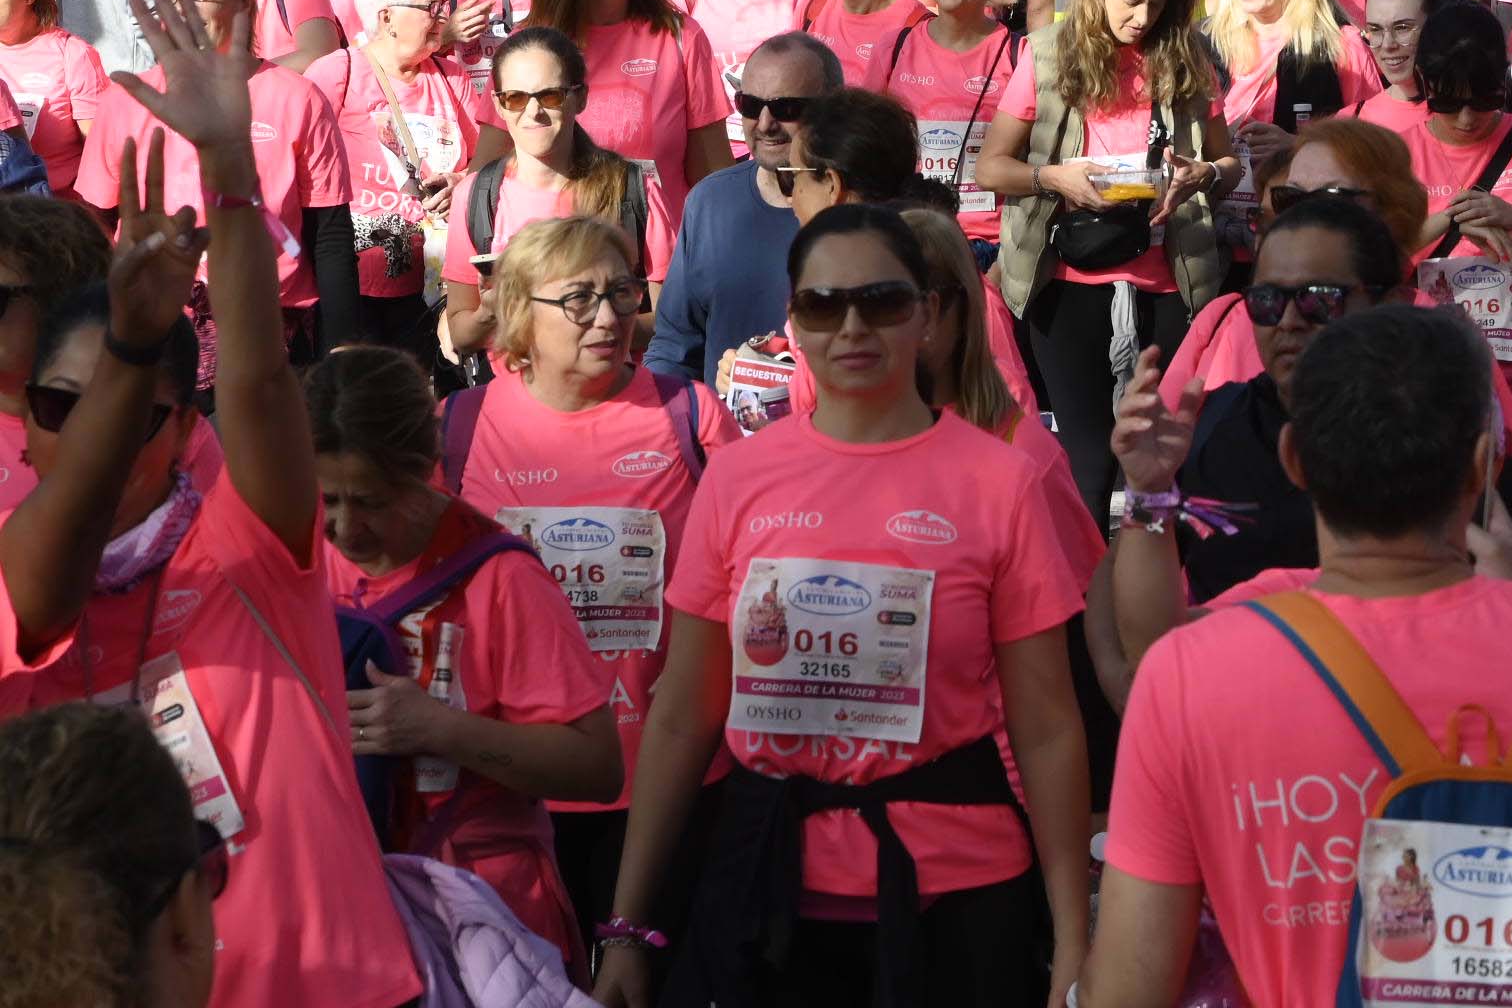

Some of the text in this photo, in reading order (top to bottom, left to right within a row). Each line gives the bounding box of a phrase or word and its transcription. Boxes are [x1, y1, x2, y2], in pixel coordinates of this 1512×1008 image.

[925, 157, 958, 170] 016
[362, 162, 389, 185] TU
[1458, 275, 1502, 285] ASTURIANA
[734, 365, 793, 384] SECUESTRA
[749, 510, 824, 533] OYSHO
[892, 517, 953, 541] ASTURIANA
[547, 527, 654, 544] ASTURIANA SUMA
[550, 564, 605, 584] 016
[792, 589, 917, 607] ASTURIANA SUMA
[576, 609, 587, 617] LA
[589, 609, 622, 617] MUJER
[599, 628, 651, 639] Santander
[794, 629, 859, 656] 016
[800, 661, 851, 678] 32165
[751, 681, 802, 693] CARRERA
[805, 684, 820, 694] DE
[822, 686, 836, 696] LA
[839, 687, 876, 697] MUJER
[746, 704, 908, 727] OYSHO Santander
[1232, 768, 1379, 831] ¡HOY
[1256, 836, 1358, 889] LAS
[1382, 984, 1452, 999] CARRERA
[1454, 985, 1472, 1000] DE
[1477, 987, 1497, 1002] LA
